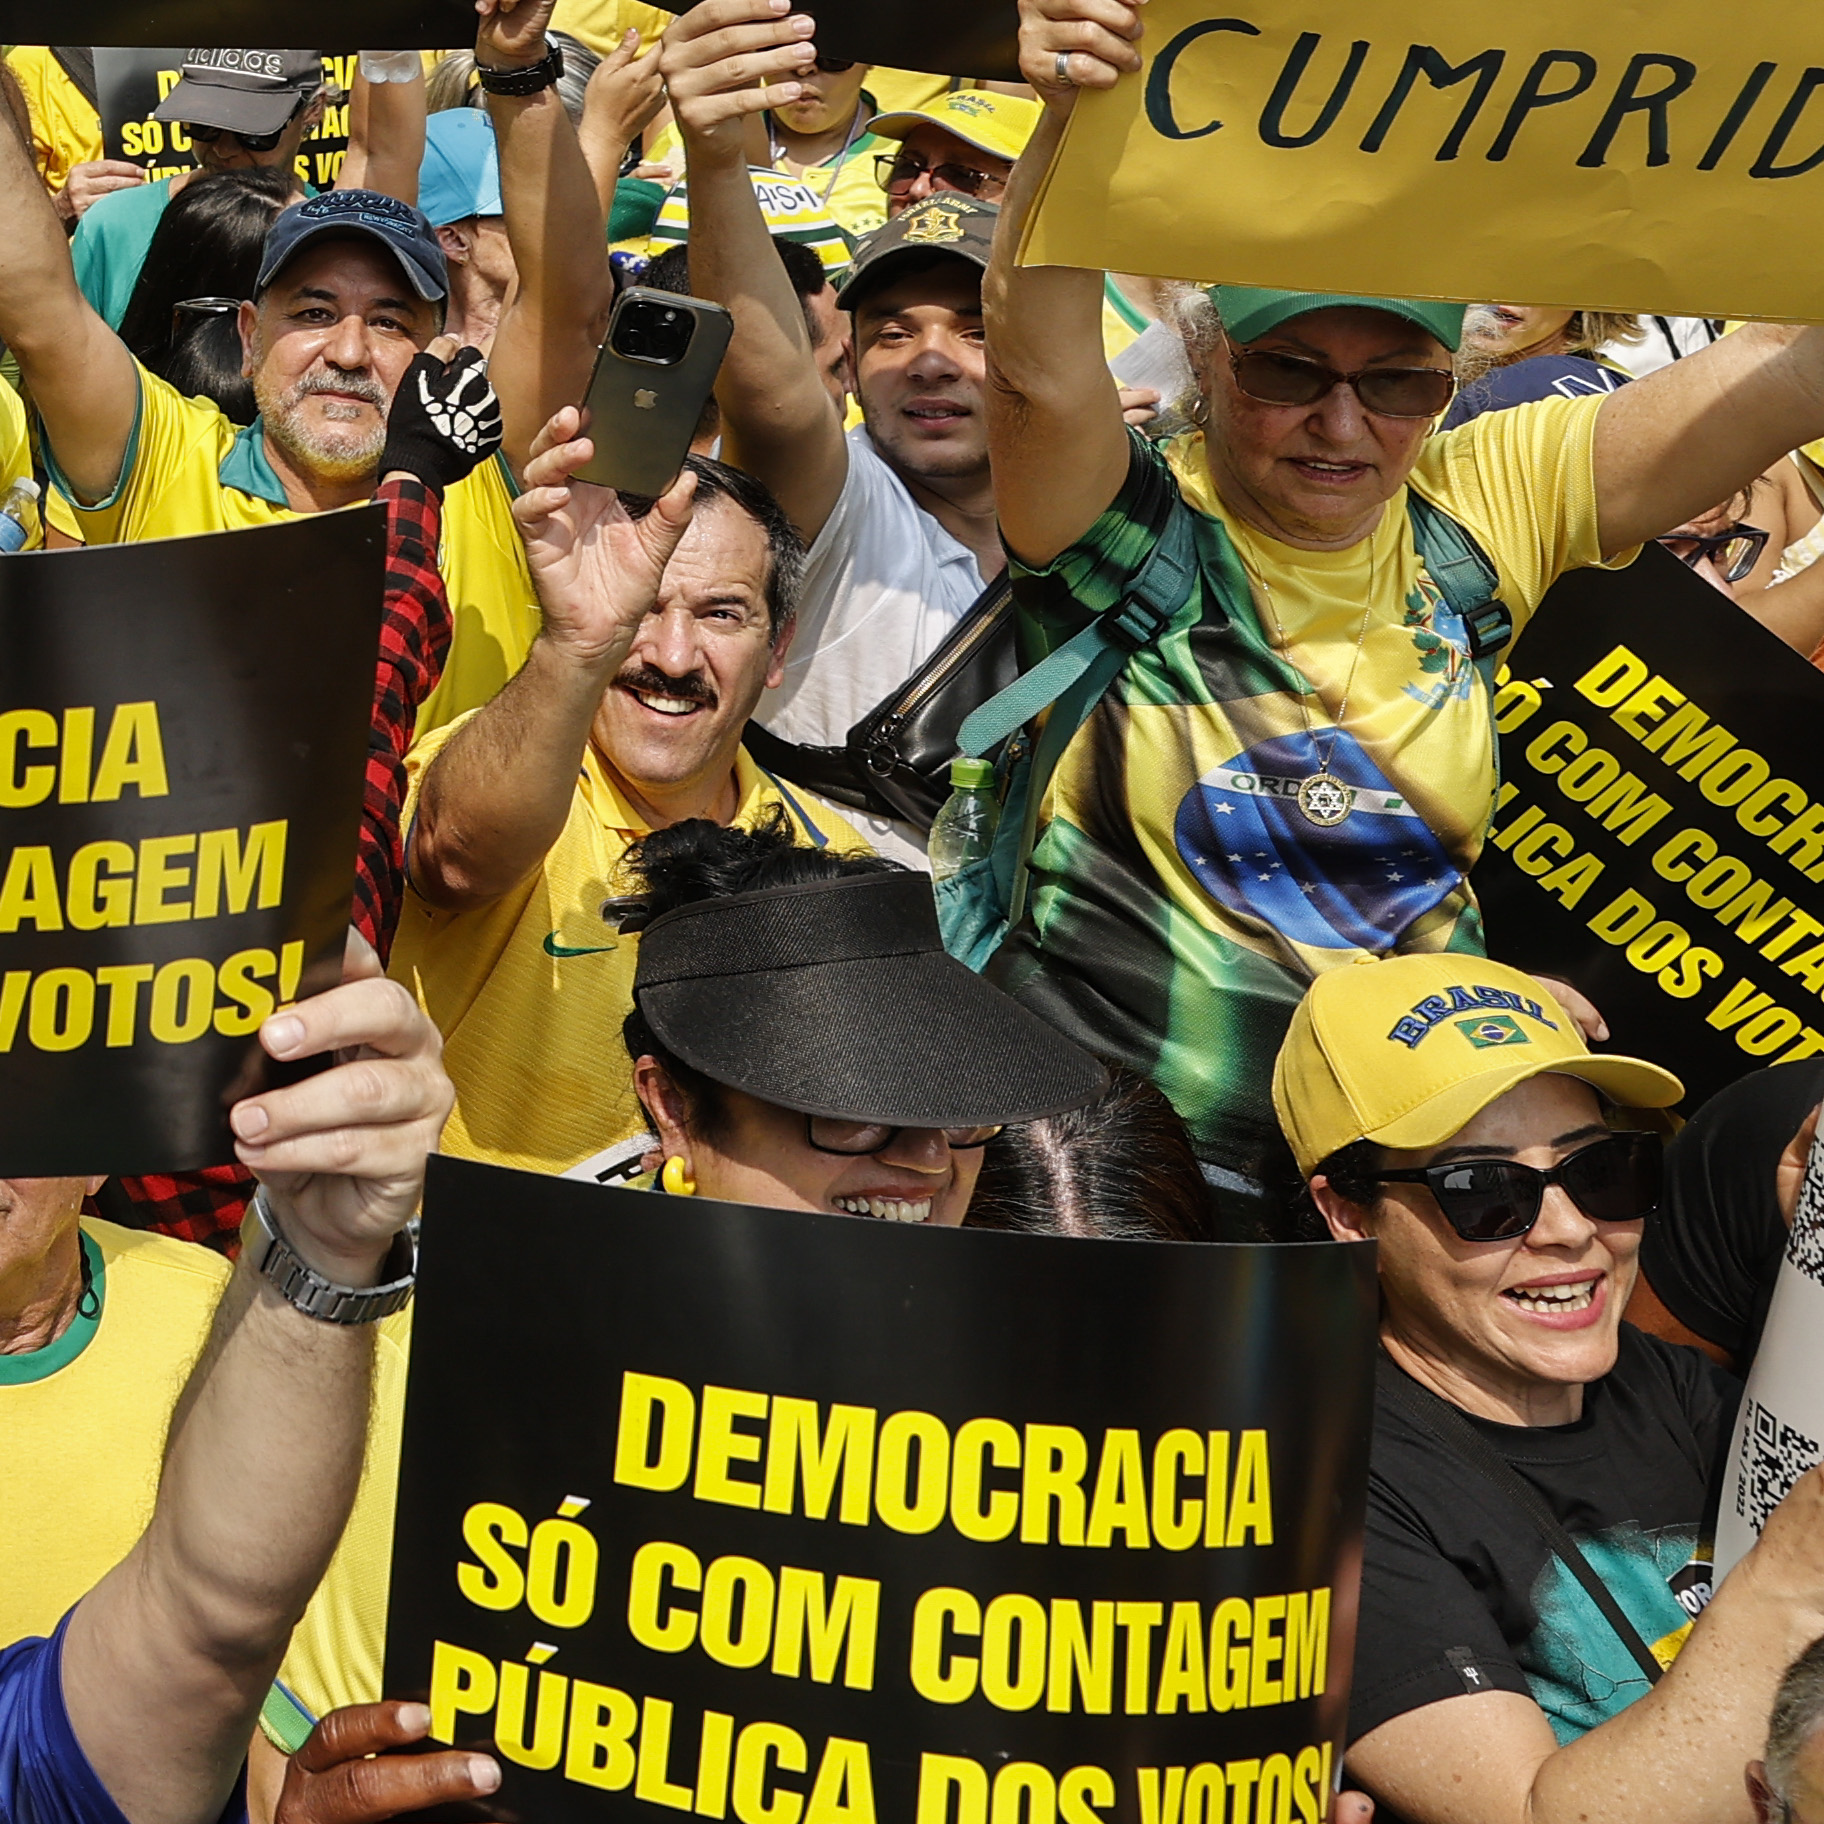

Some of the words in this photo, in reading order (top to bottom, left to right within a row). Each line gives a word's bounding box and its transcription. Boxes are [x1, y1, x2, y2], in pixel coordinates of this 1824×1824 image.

[1524, 723, 1675, 848] COM
[1586, 885, 1725, 1001] DOS
[1387, 982, 1559, 1051] BRASIL
[612, 1369, 1275, 1551] DEMOCRACIA
[455, 1494, 600, 1629] SÓ
[625, 1541, 881, 1691] COM
[907, 1585, 1332, 1717] CONTAGEM
